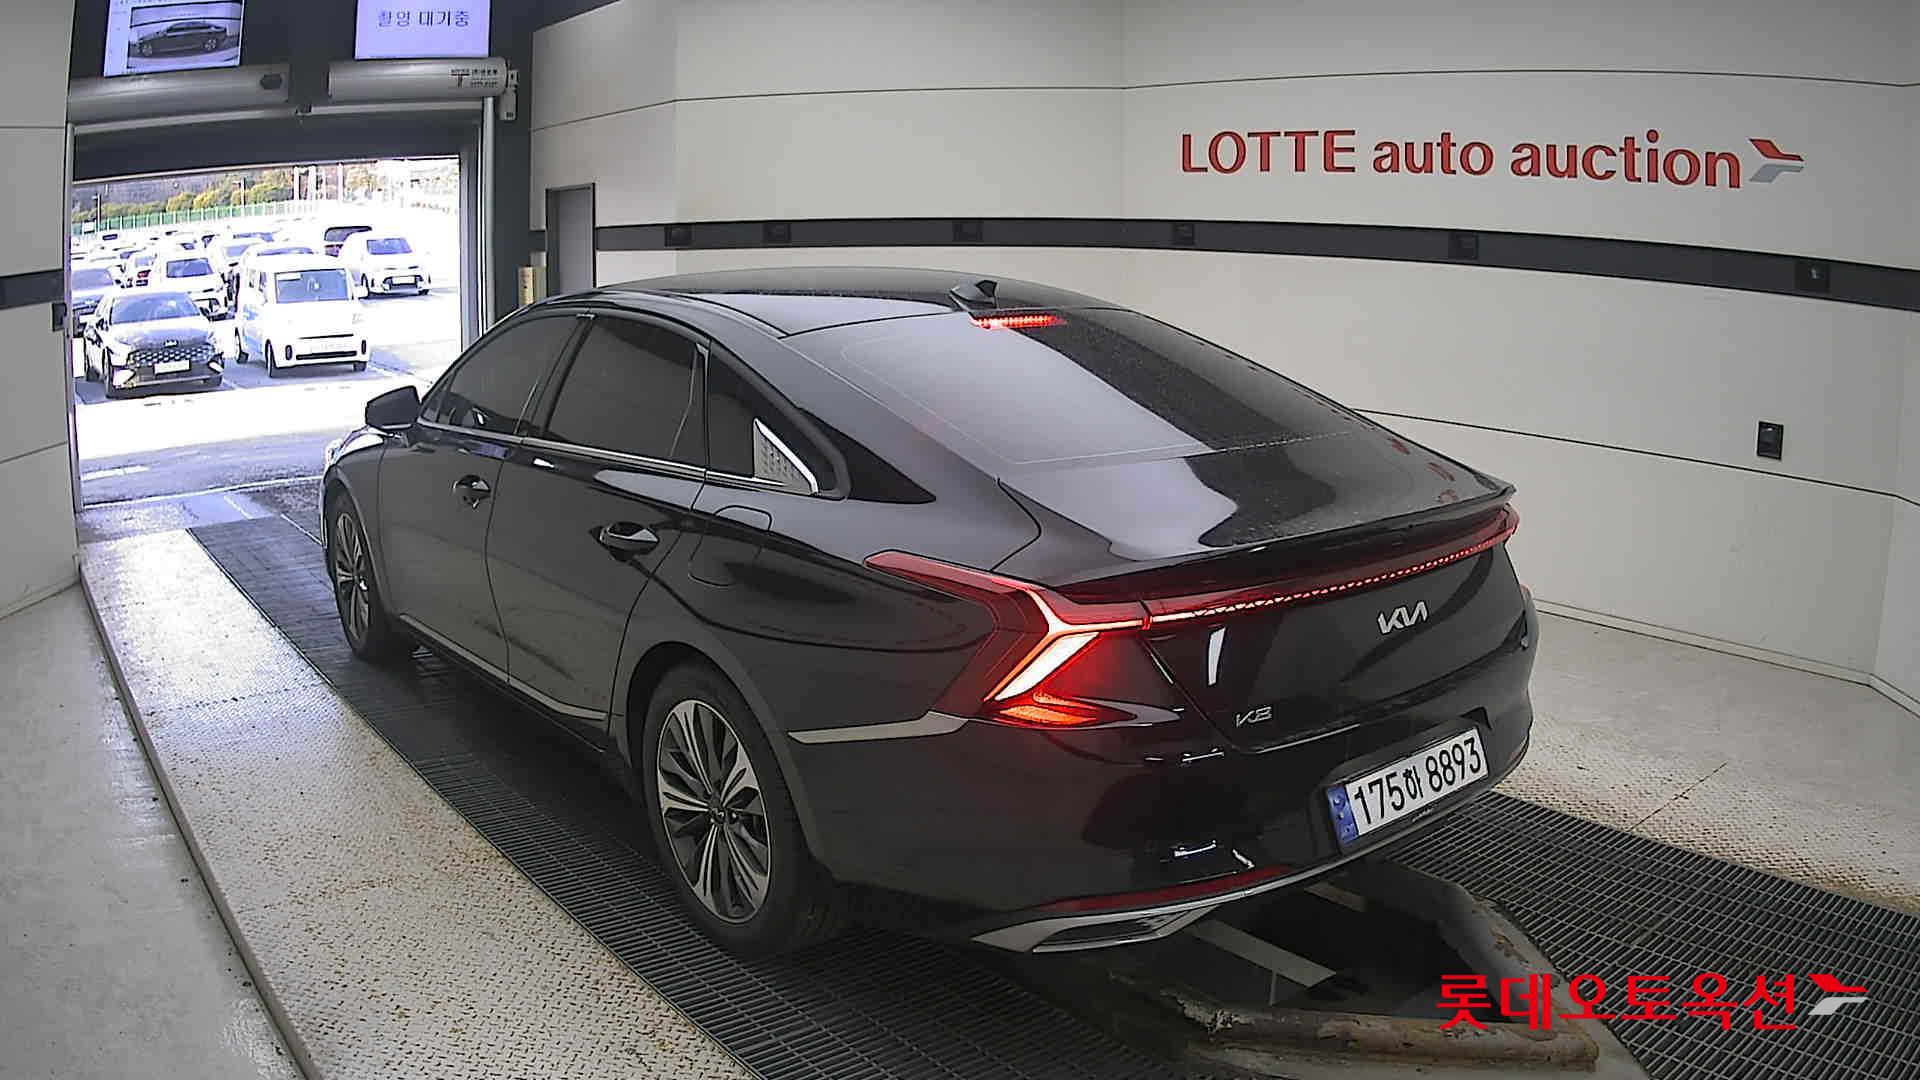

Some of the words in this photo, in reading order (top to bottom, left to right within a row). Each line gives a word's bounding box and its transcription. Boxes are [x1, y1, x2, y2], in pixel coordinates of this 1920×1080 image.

[418, 9, 470, 27] 대기중
[1182, 129, 1356, 174] LOTTE
[1372, 132, 1495, 175] auto
[1510, 129, 1742, 189] auction
[1425, 737, 1482, 793] 8893
